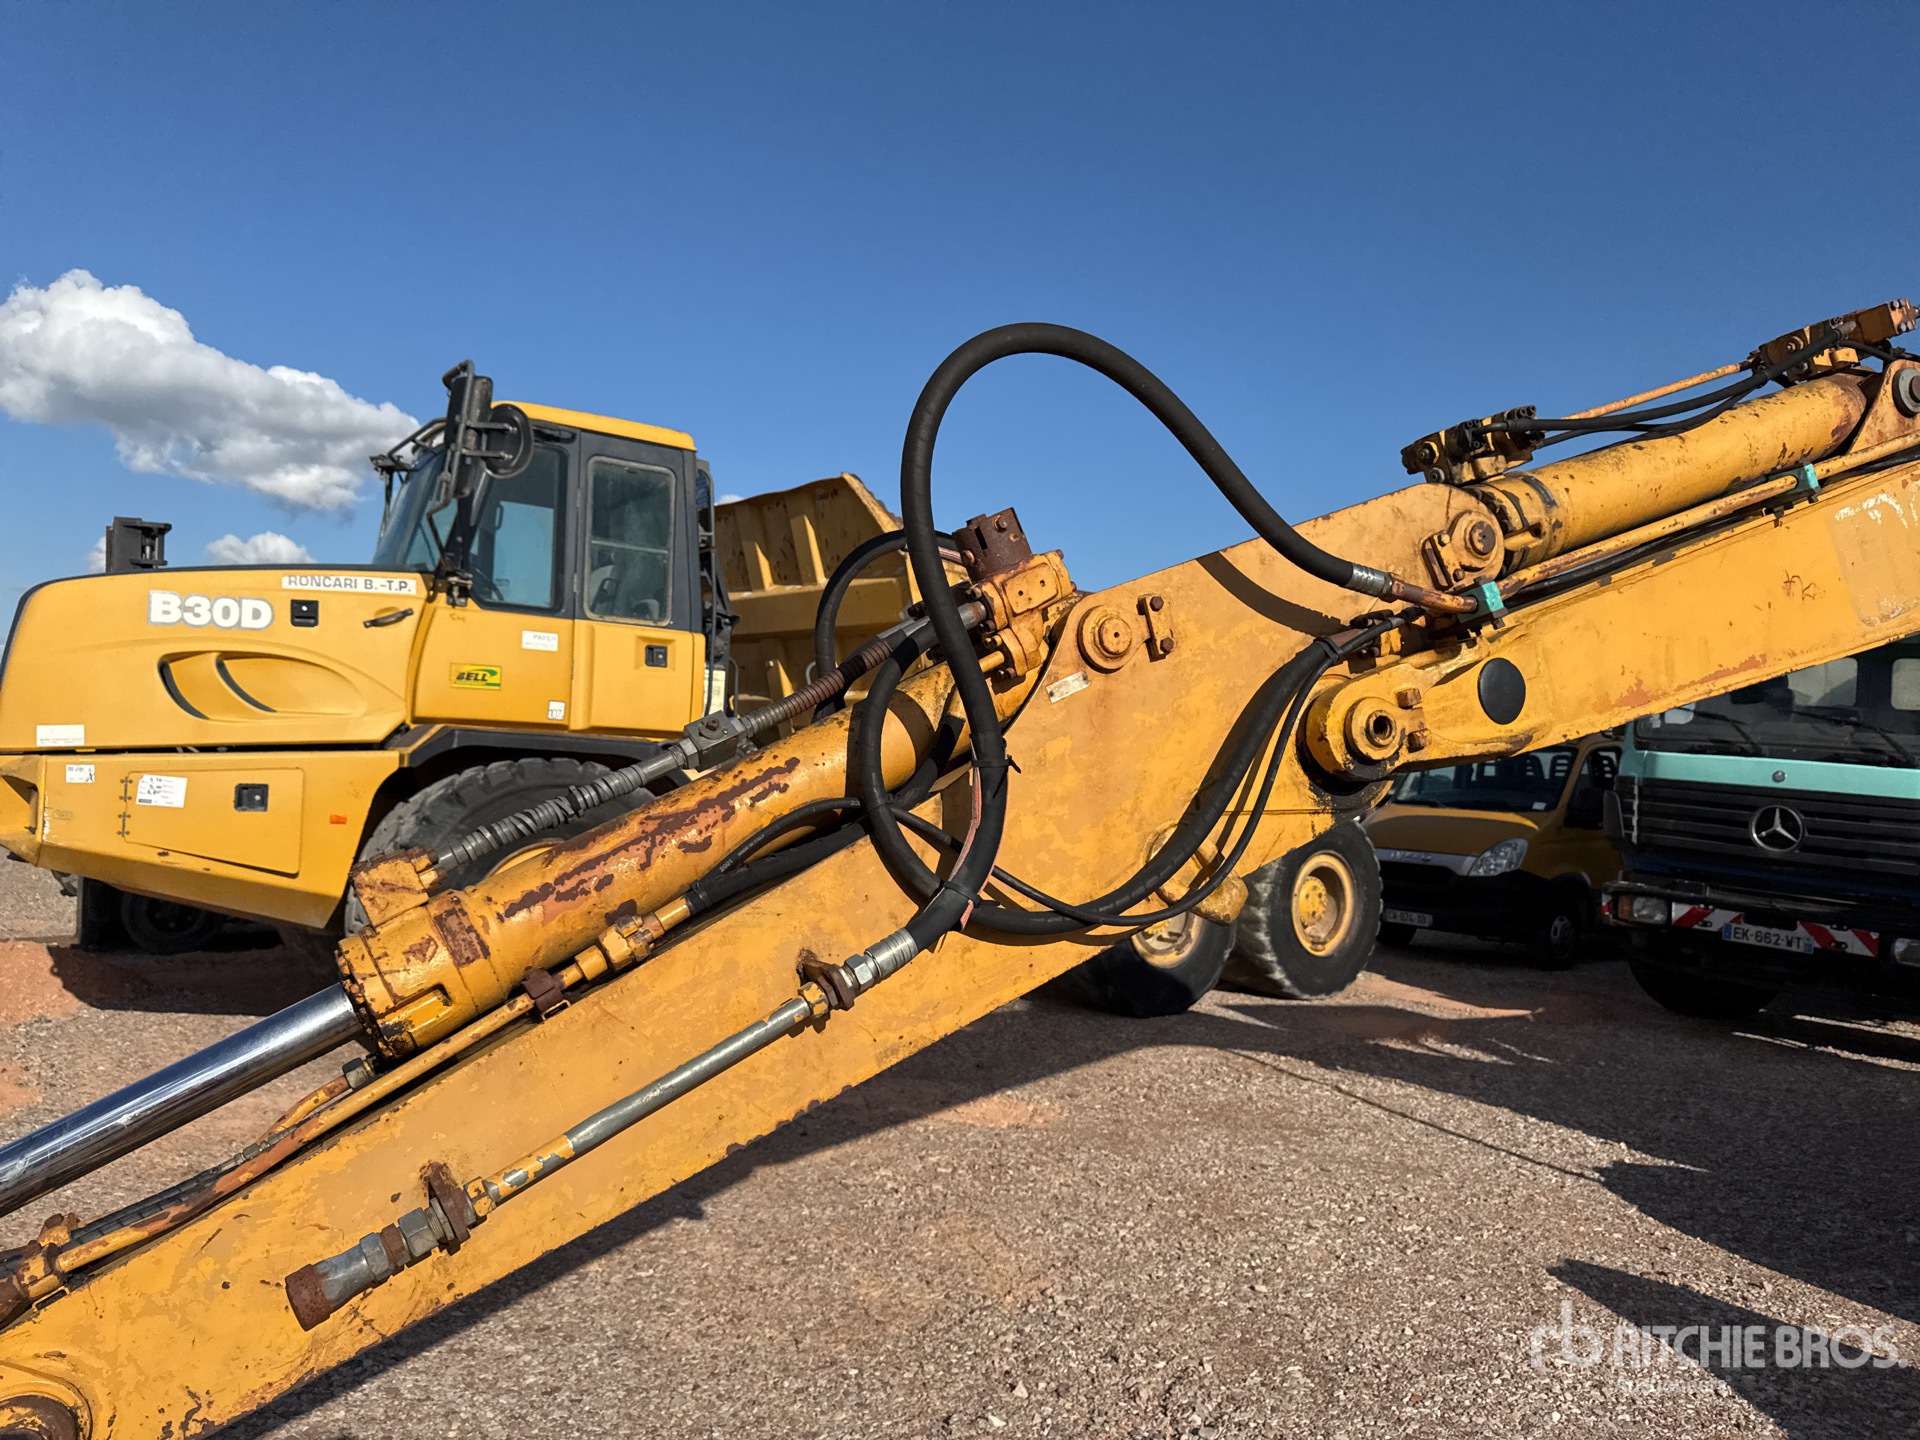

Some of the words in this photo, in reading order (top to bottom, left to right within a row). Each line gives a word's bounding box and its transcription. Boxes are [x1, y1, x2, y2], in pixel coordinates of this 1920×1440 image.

[288, 575, 358, 589] RONCARI
[148, 590, 273, 630] B30D
[455, 671, 488, 682] BELL
